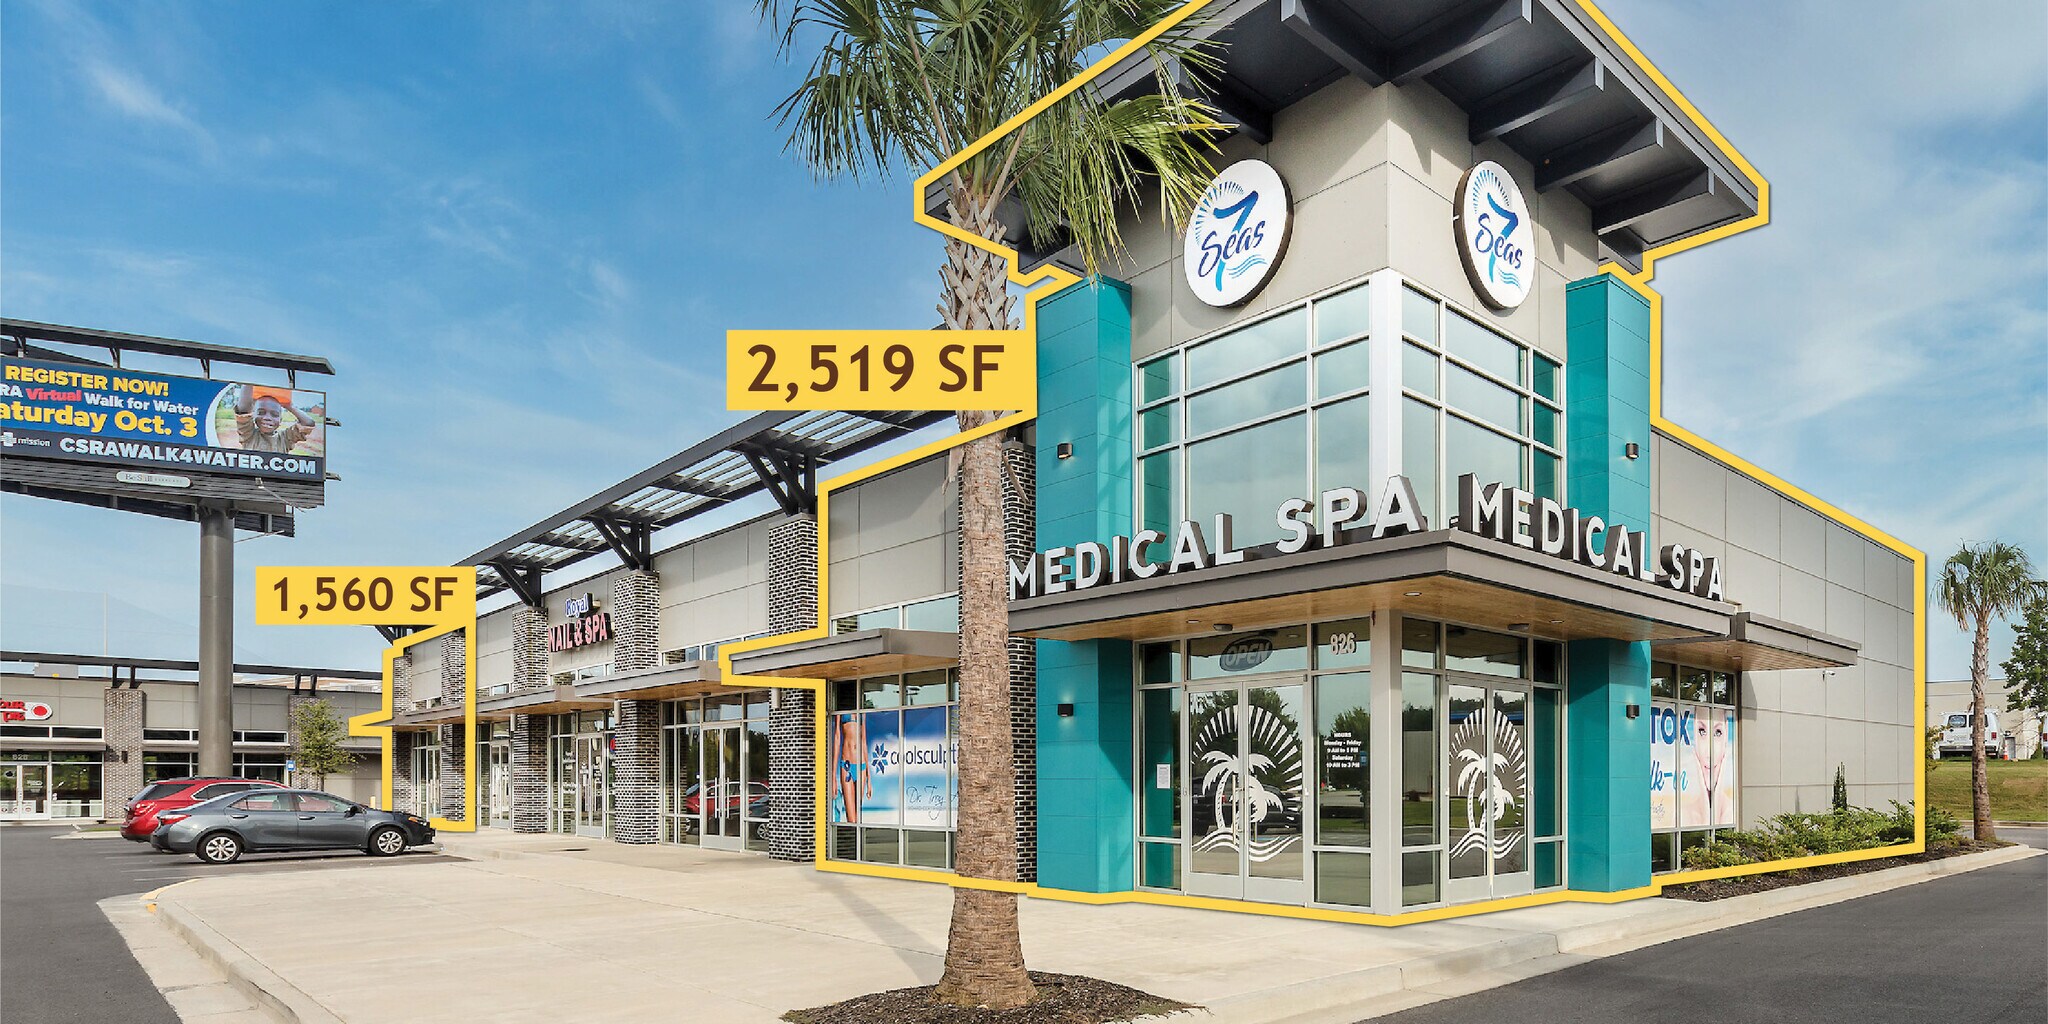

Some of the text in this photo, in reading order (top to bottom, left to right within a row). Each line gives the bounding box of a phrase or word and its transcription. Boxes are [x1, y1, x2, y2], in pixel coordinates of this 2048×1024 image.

[1198, 220, 1266, 277] Seas
[1213, 190, 1259, 292] 7
[1475, 213, 1523, 269] Seas
[1486, 192, 1519, 283] 7
[5, 365, 169, 397] REGISTER NOW!
[26, 388, 82, 402] Virtual
[84, 392, 124, 409] Walk
[127, 398, 150, 411] for
[153, 400, 199, 417] Water
[114, 410, 173, 436] Oct.
[179, 417, 198, 438] 3
[18, 437, 51, 447] mission
[60, 437, 316, 475] CSRAWALK4WATER.COM
[1009, 474, 1422, 600] MEDICAL SPA
[1465, 472, 1724, 602] MEDICAL SPA
[565, 593, 589, 618] Royal
[547, 612, 608, 653] NAIL & SPA
[1330, 632, 1357, 656] 826
[1224, 640, 1271, 666] OPEN
[906, 786, 922, 804] Dr.
